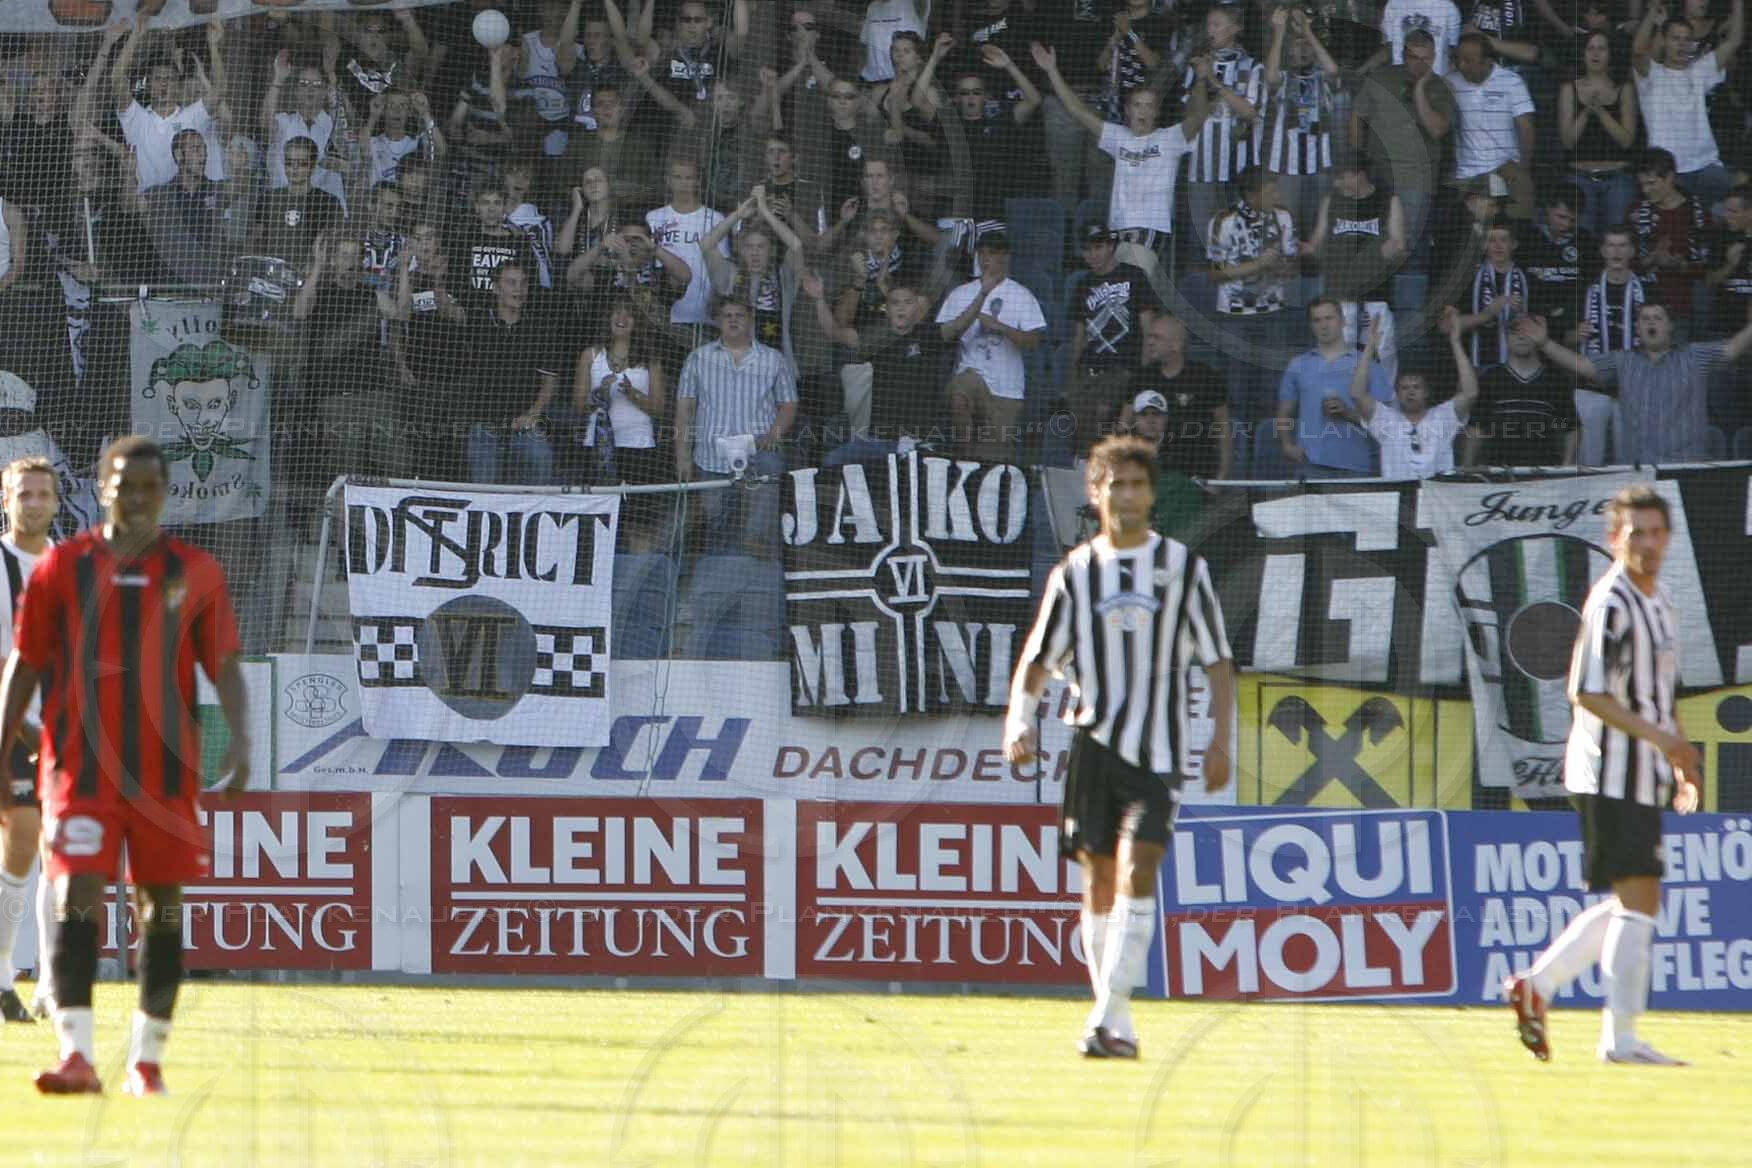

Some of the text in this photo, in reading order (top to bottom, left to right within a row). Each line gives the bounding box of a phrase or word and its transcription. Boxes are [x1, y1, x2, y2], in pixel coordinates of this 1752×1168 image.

[450, 815, 746, 886] KLEINE
[1173, 820, 1434, 905] LIQUI
[449, 906, 751, 959] ZEITUNG
[1180, 910, 1446, 996] MOLY
